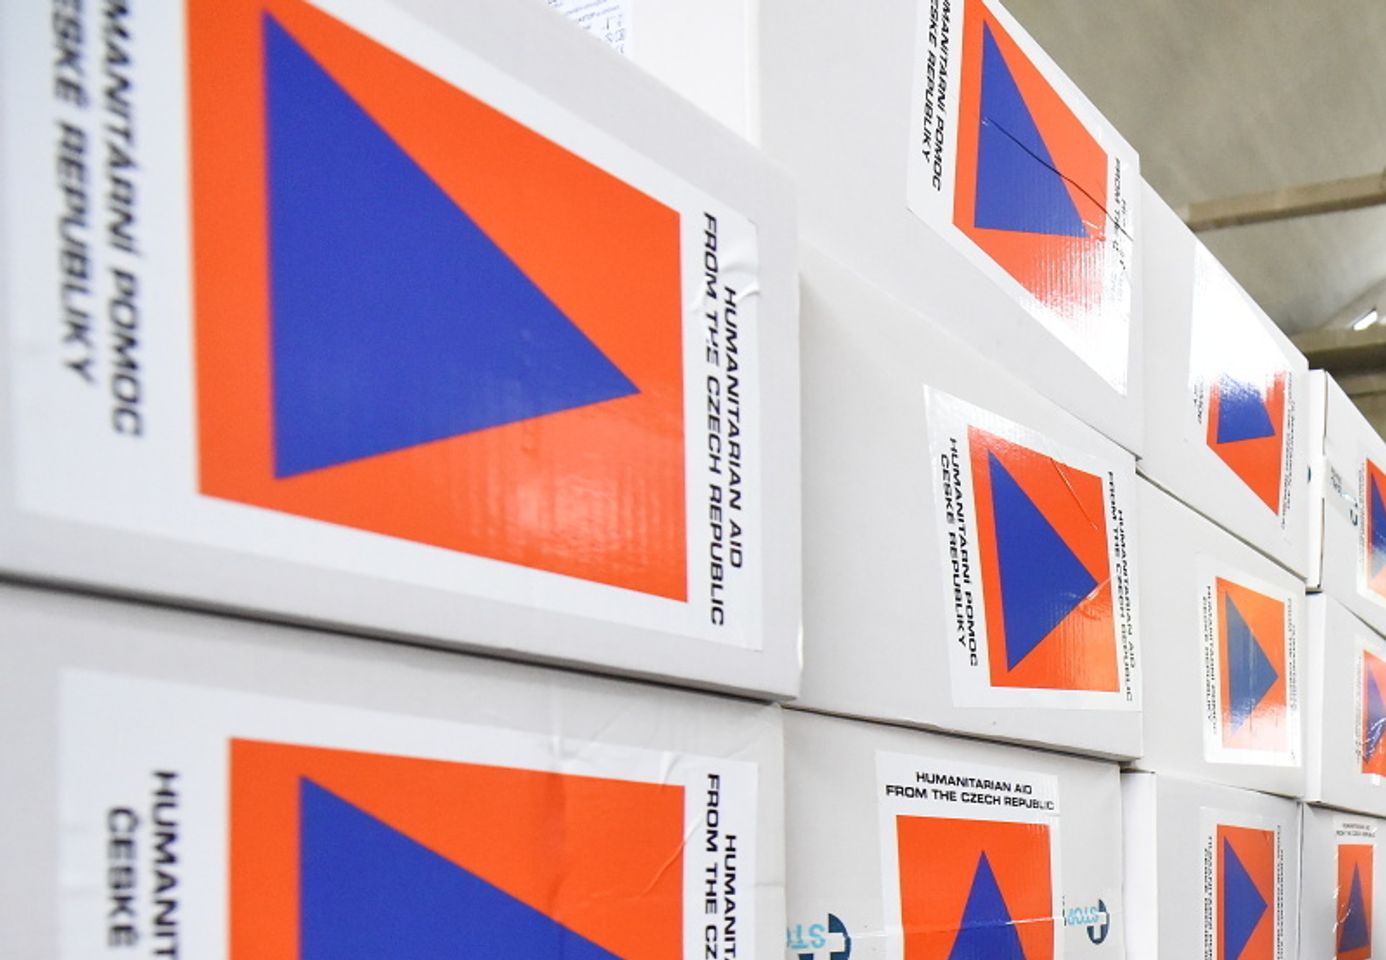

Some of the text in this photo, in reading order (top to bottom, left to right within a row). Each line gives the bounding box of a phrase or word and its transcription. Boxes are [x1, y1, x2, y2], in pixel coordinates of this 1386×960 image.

[922, 49, 937, 163] REPUBLIKY
[932, 114, 945, 192] POMOC
[56, 121, 96, 386] REPUBLIKY
[102, 0, 143, 438] MANITÁRNÍ POMOC
[703, 211, 725, 627] FROM THE CZECH REPUBLIC
[723, 285, 744, 569] HUMANITARIAN AID
[949, 531, 967, 648] REPUBLIKY
[965, 590, 978, 668] POMOC
[705, 772, 720, 853] FROM
[886, 784, 1055, 811] FROM THE CZECH REPUBLIC
[916, 771, 1033, 795] HUMANITARIAN AID
[704, 862, 719, 913] THE
